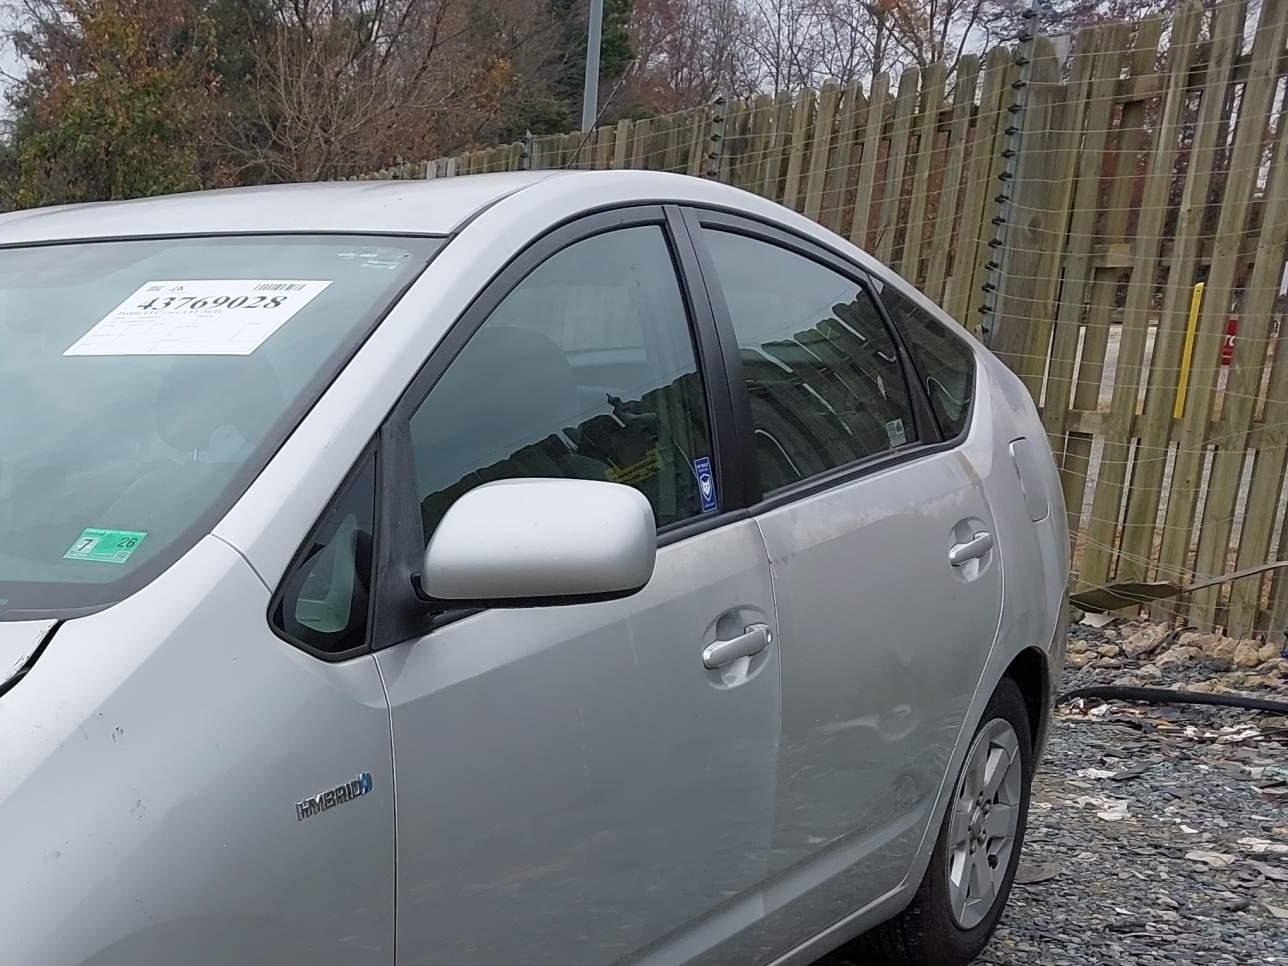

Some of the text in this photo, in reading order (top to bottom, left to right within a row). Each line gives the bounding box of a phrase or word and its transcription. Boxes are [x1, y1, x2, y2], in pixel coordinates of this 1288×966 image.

[137, 295, 288, 310] 43769028
[78, 539, 94, 551] 7
[117, 537, 138, 548] 26
[295, 779, 363, 821] HYBRID
